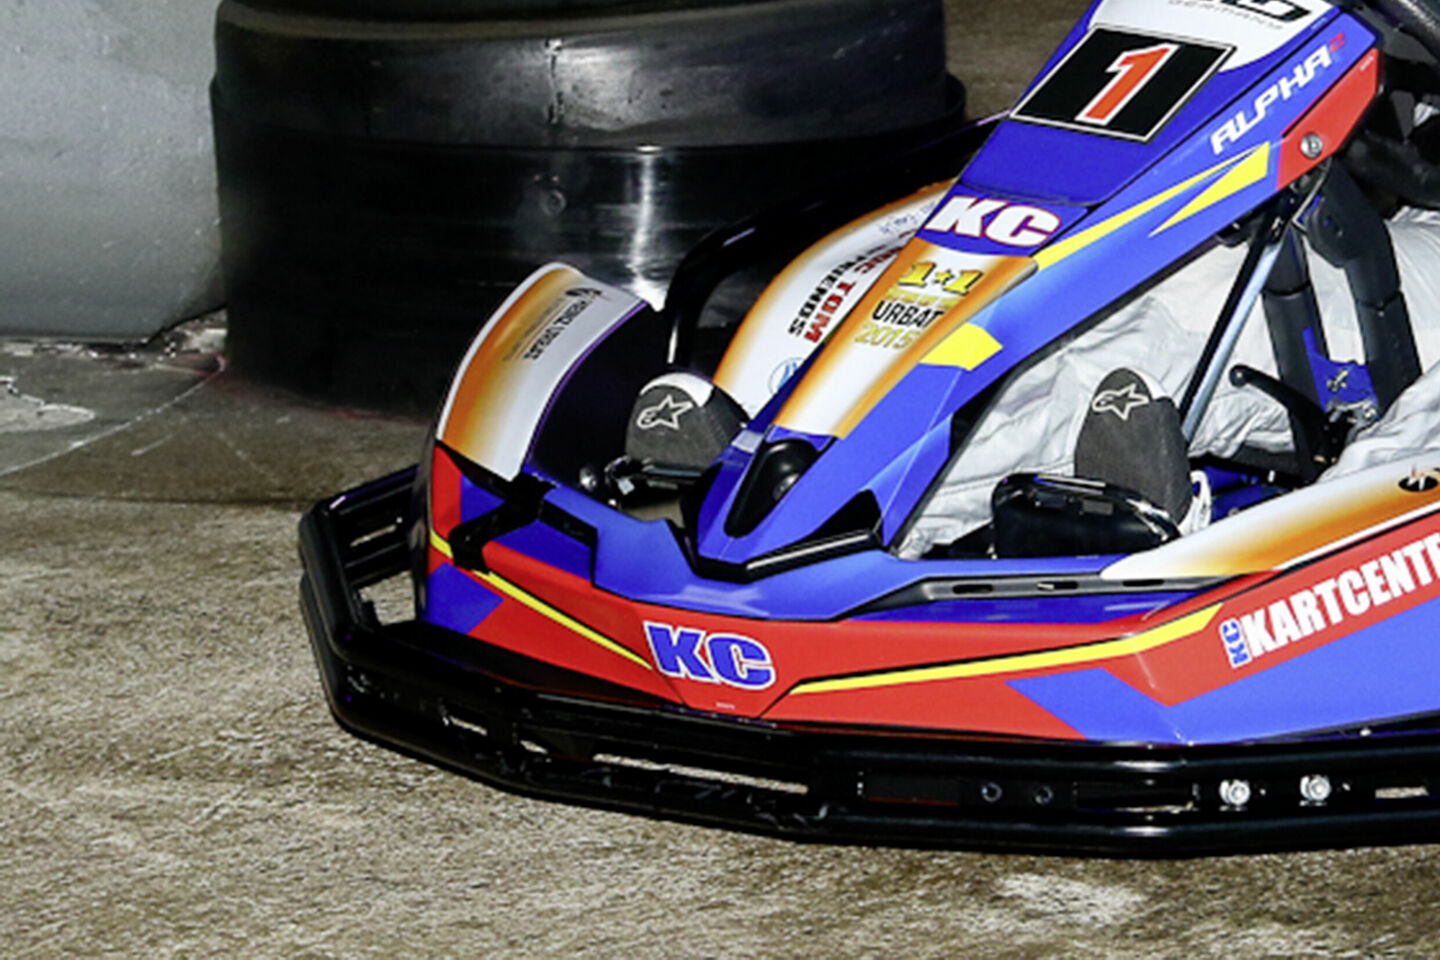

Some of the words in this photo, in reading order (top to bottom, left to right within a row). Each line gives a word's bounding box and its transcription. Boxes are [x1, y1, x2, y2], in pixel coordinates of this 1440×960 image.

[1075, 42, 1180, 127] 1
[1210, 44, 1332, 155] ALPHA
[922, 195, 1062, 247] KC
[803, 281, 857, 343] TOM
[643, 621, 776, 691] KC
